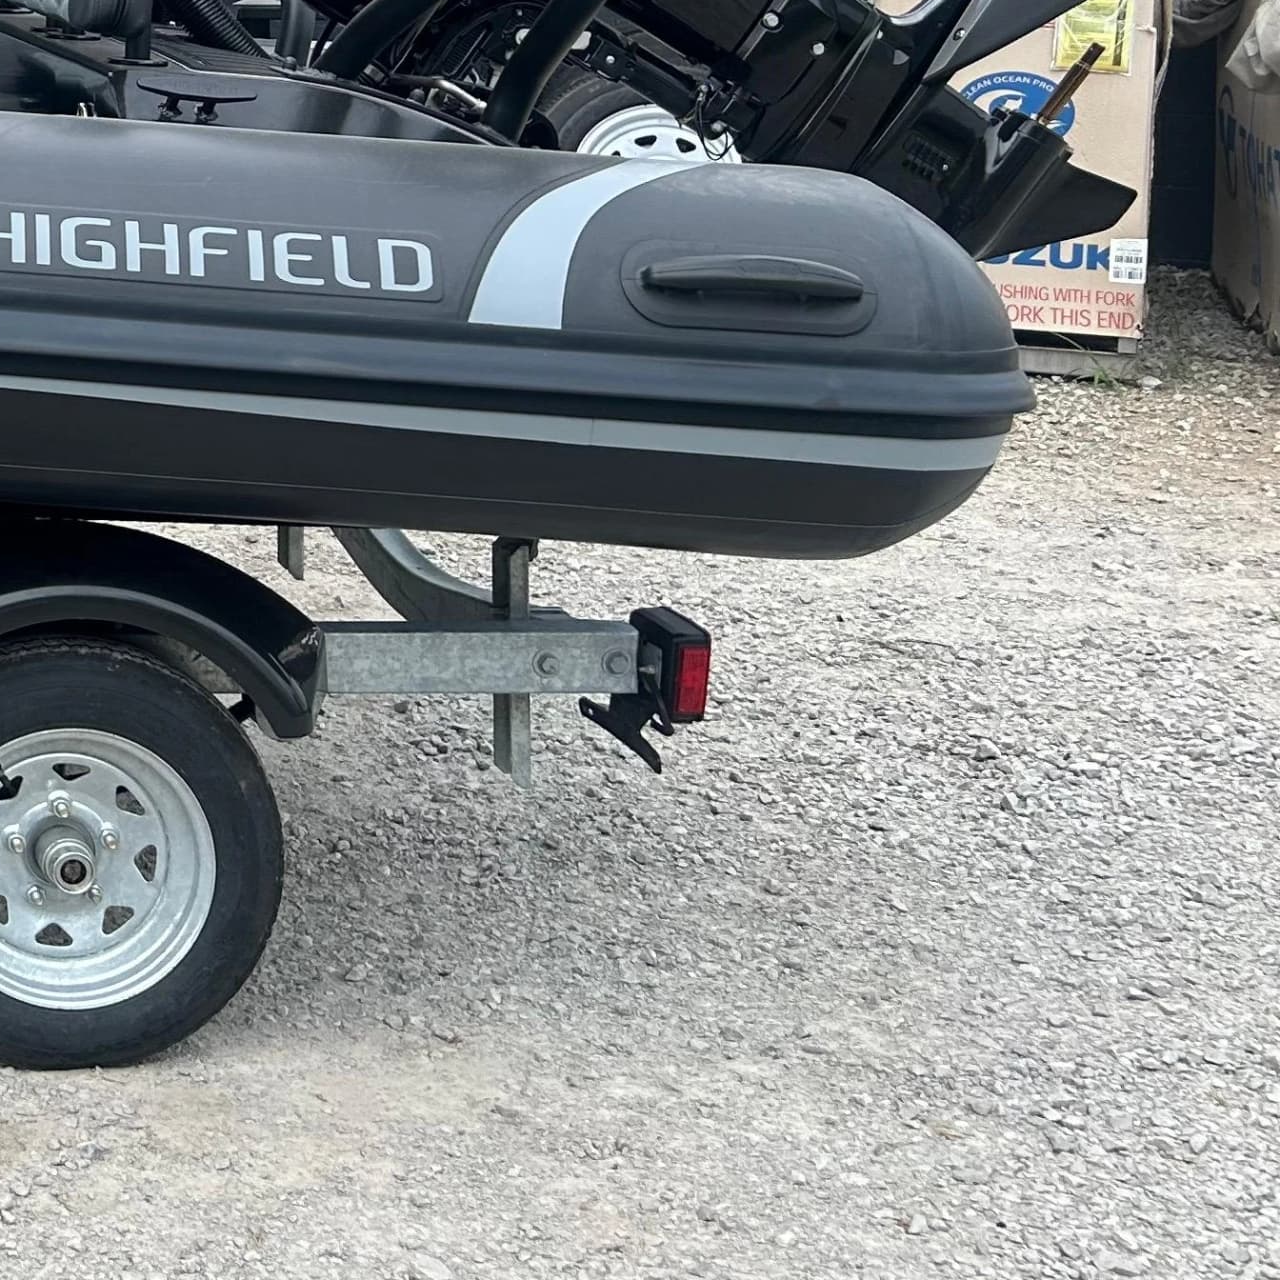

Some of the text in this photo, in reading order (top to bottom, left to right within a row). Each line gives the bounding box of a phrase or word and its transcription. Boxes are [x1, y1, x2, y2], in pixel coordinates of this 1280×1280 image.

[993, 74, 1031, 85] OCEAN
[1053, 287, 1090, 304] WITH
[1095, 290, 1136, 307] FORK
[1007, 304, 1135, 331] ORK THIS END
